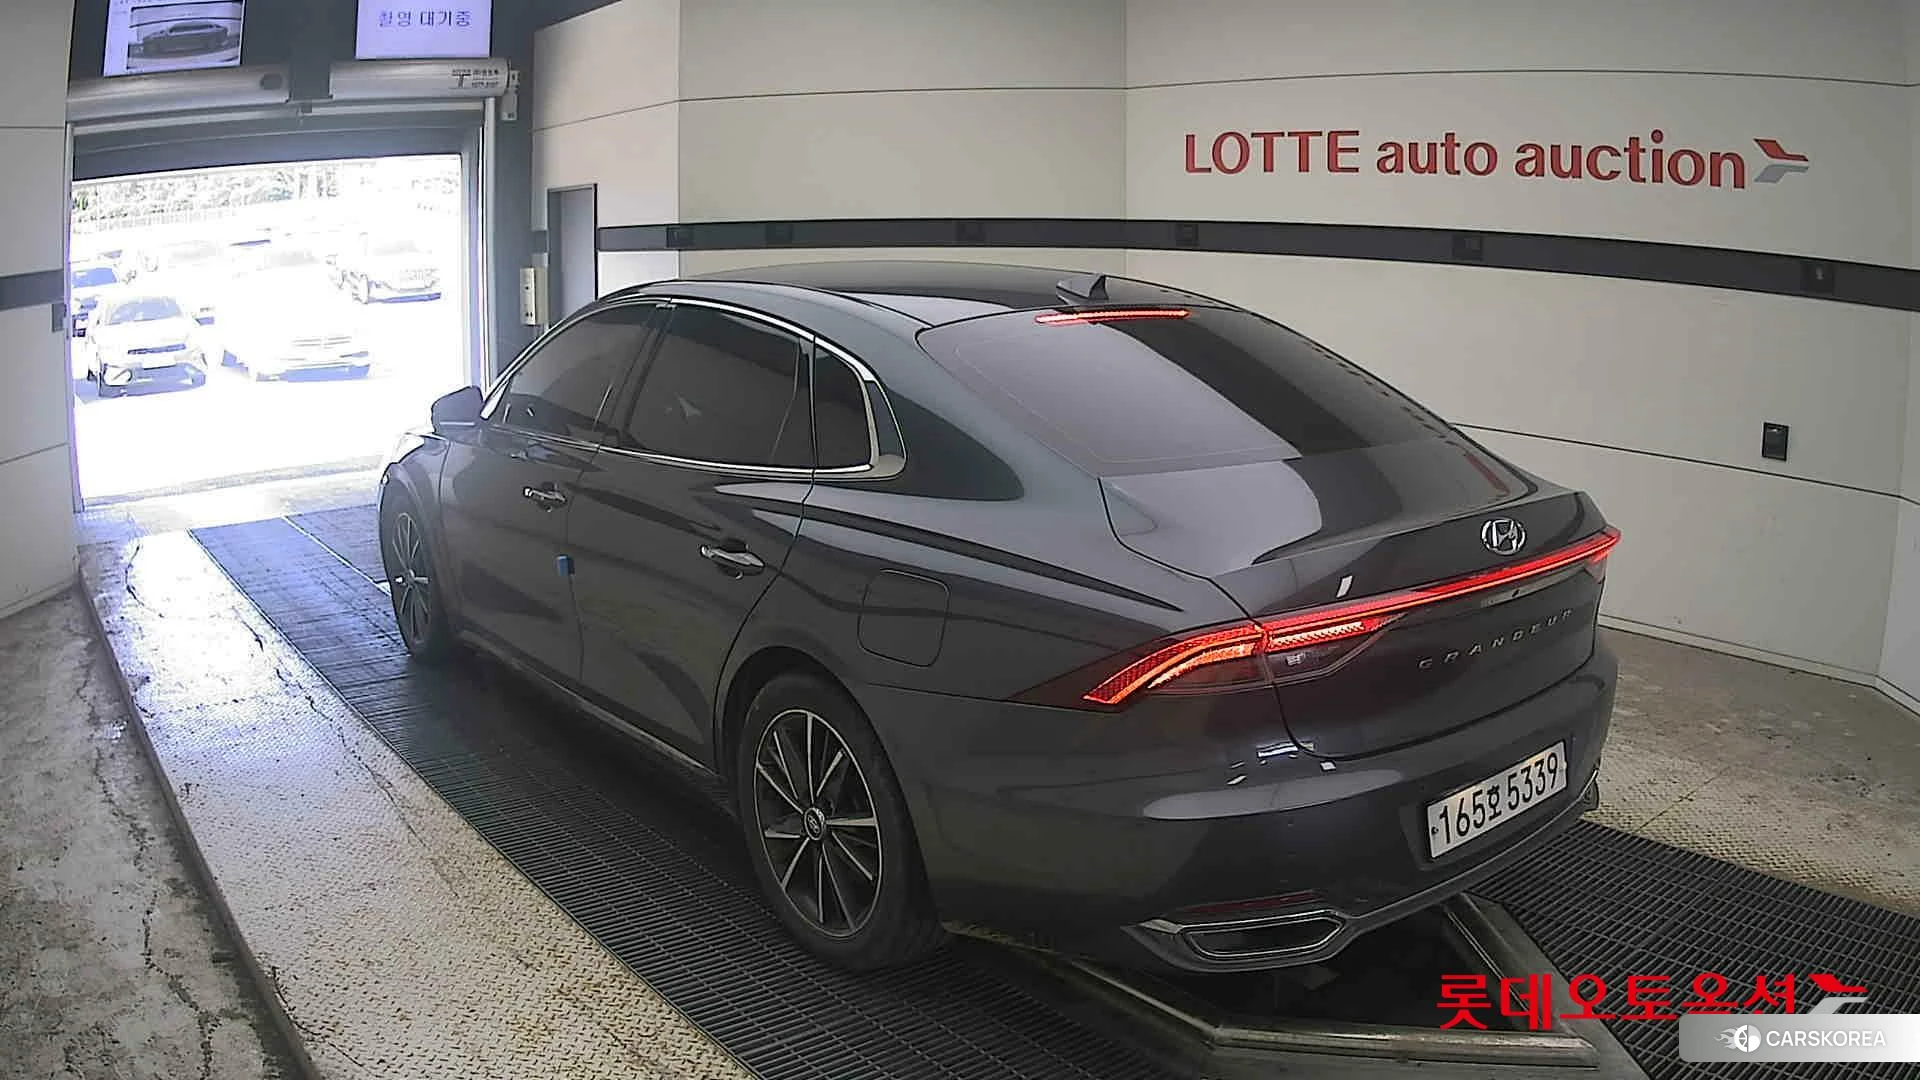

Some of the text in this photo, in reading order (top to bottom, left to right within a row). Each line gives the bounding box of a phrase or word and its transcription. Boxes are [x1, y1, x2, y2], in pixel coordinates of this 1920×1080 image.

[420, 10, 472, 27] 대기중
[1185, 129, 1745, 189] LOTTE auto auction
[1418, 608, 1572, 669] GRANDEUR
[1507, 752, 1558, 811] 5339
